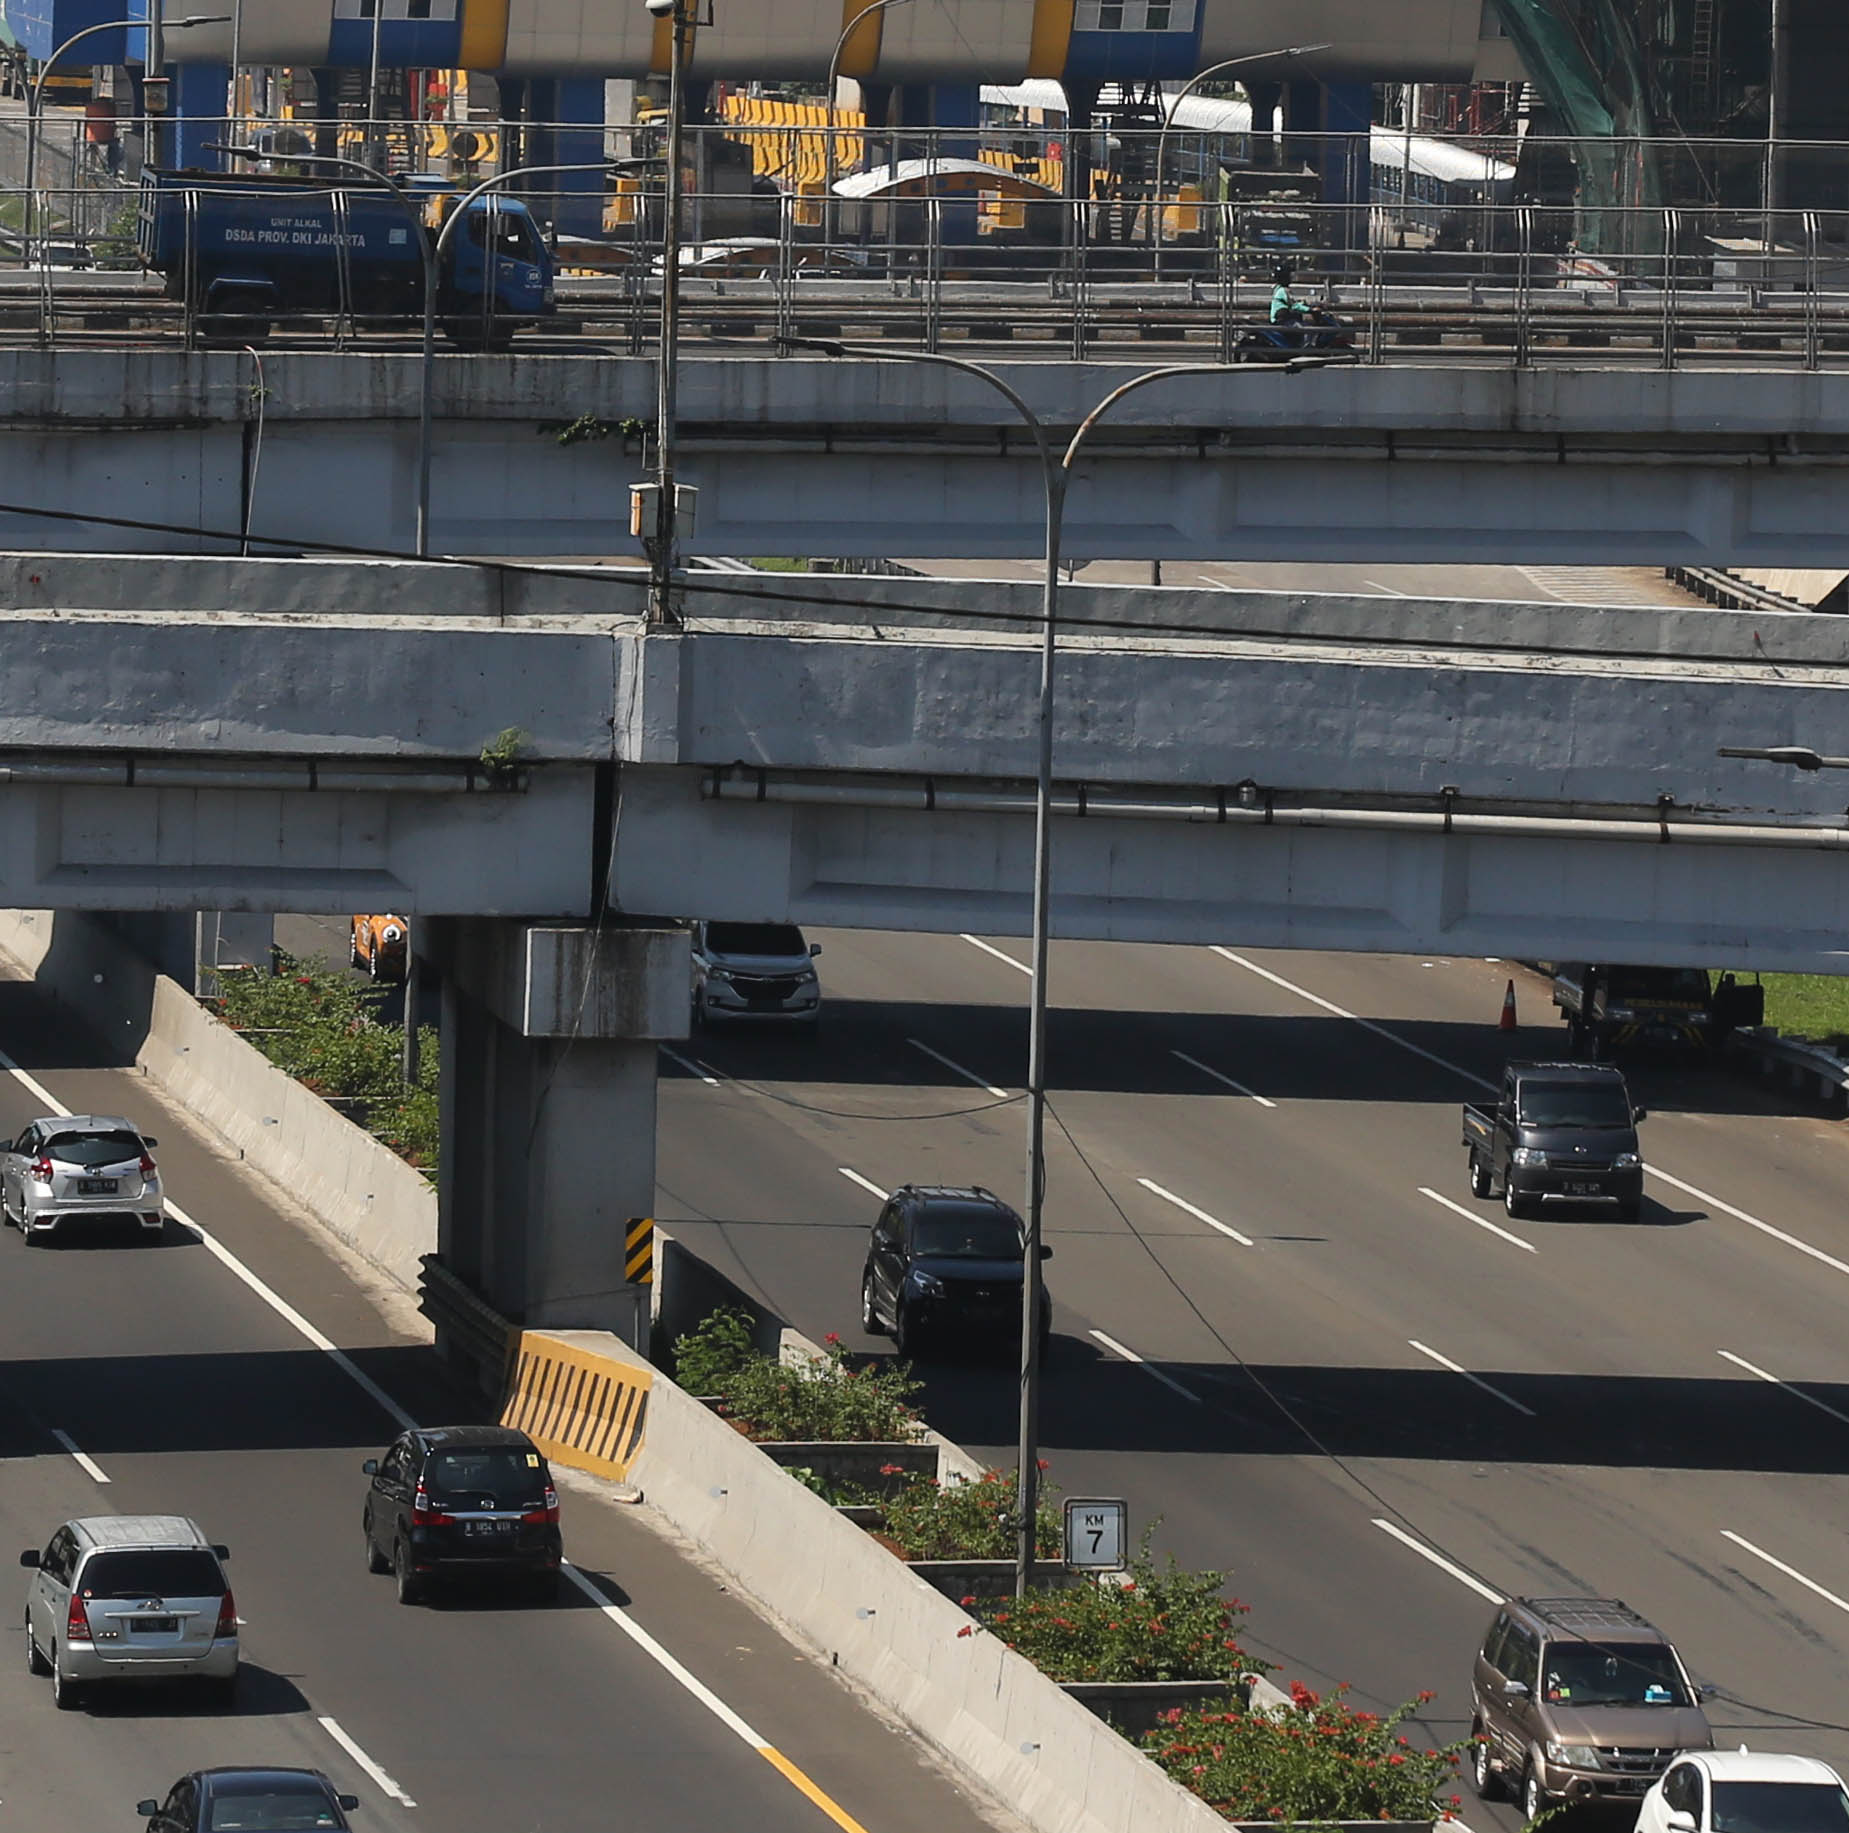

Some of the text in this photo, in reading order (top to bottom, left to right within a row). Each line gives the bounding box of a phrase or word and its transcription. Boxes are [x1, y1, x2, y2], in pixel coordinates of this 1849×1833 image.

[225, 228, 366, 248] DSDA PROV. DKI JAKARTA
[1085, 1514, 1104, 1526] KM
[1086, 1529, 1104, 1555] 7
